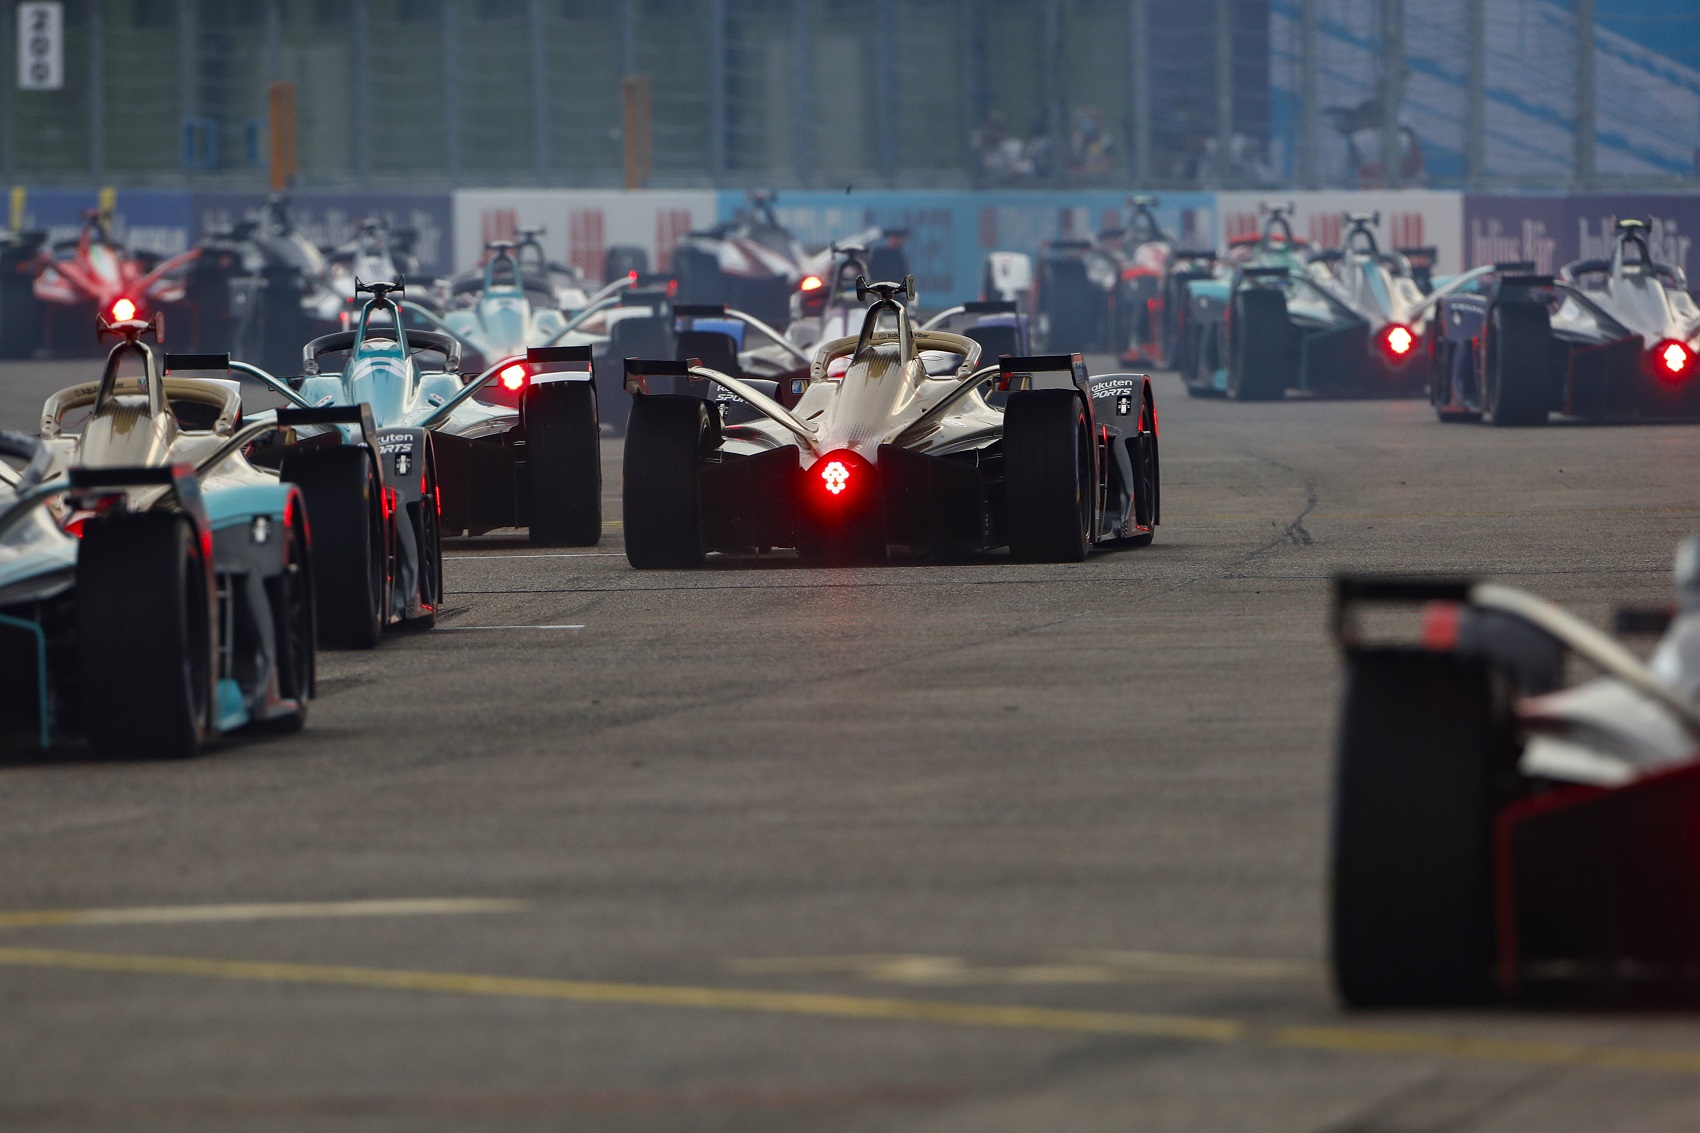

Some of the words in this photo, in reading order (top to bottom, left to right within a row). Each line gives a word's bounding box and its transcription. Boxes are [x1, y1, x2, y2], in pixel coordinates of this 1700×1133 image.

[29, 8, 51, 82] 200
[1091, 379, 1133, 392] akuten
[715, 393, 748, 403] SPO
[1092, 387, 1132, 399] PORTS
[378, 433, 414, 444] uten
[379, 443, 413, 454] RTS
